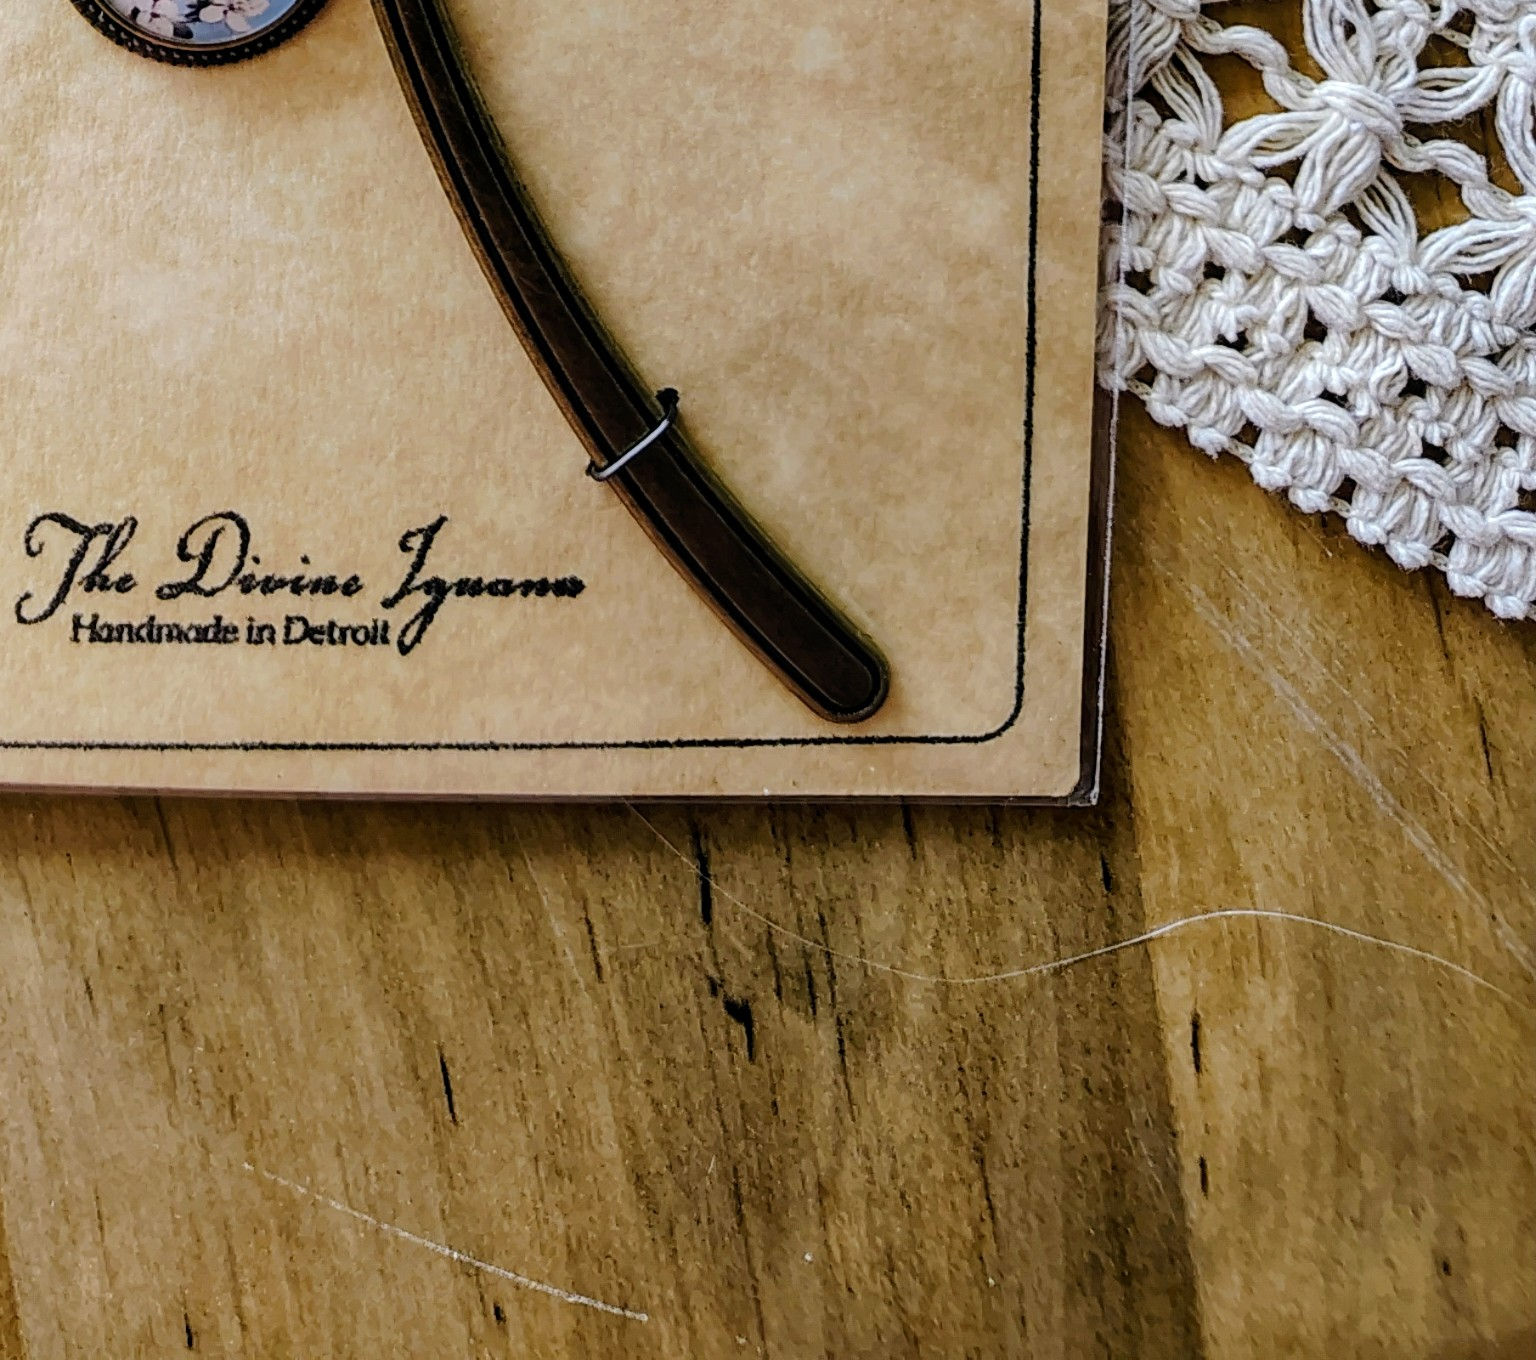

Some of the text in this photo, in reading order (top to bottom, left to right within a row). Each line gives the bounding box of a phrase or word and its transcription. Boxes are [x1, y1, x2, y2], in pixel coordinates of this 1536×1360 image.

[15, 510, 587, 656] The Divine Iguana
[70, 613, 390, 647] Handmade in Detroit
